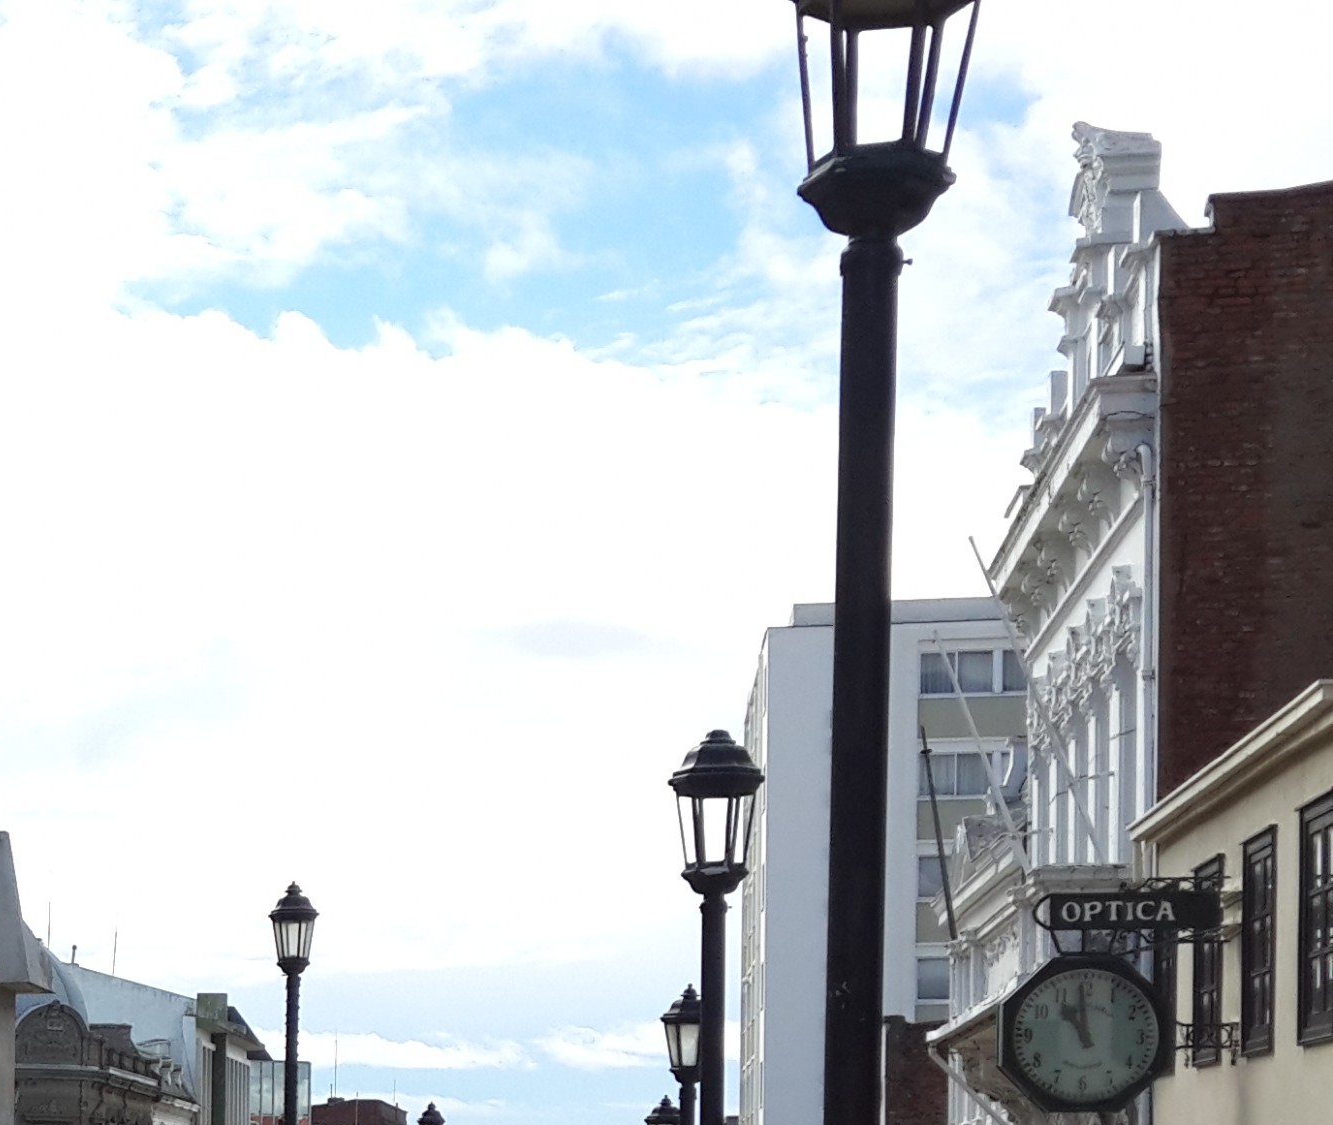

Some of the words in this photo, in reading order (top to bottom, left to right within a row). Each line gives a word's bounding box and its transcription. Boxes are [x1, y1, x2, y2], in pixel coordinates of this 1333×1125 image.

[1061, 900, 1176, 922] OPTICA
[1034, 1004, 1049, 1020] 10
[1024, 1028, 1033, 1043] 9
[1135, 1029, 1146, 1046] 3
[1033, 1052, 1042, 1068] 8
[1053, 1069, 1062, 1085] 7
